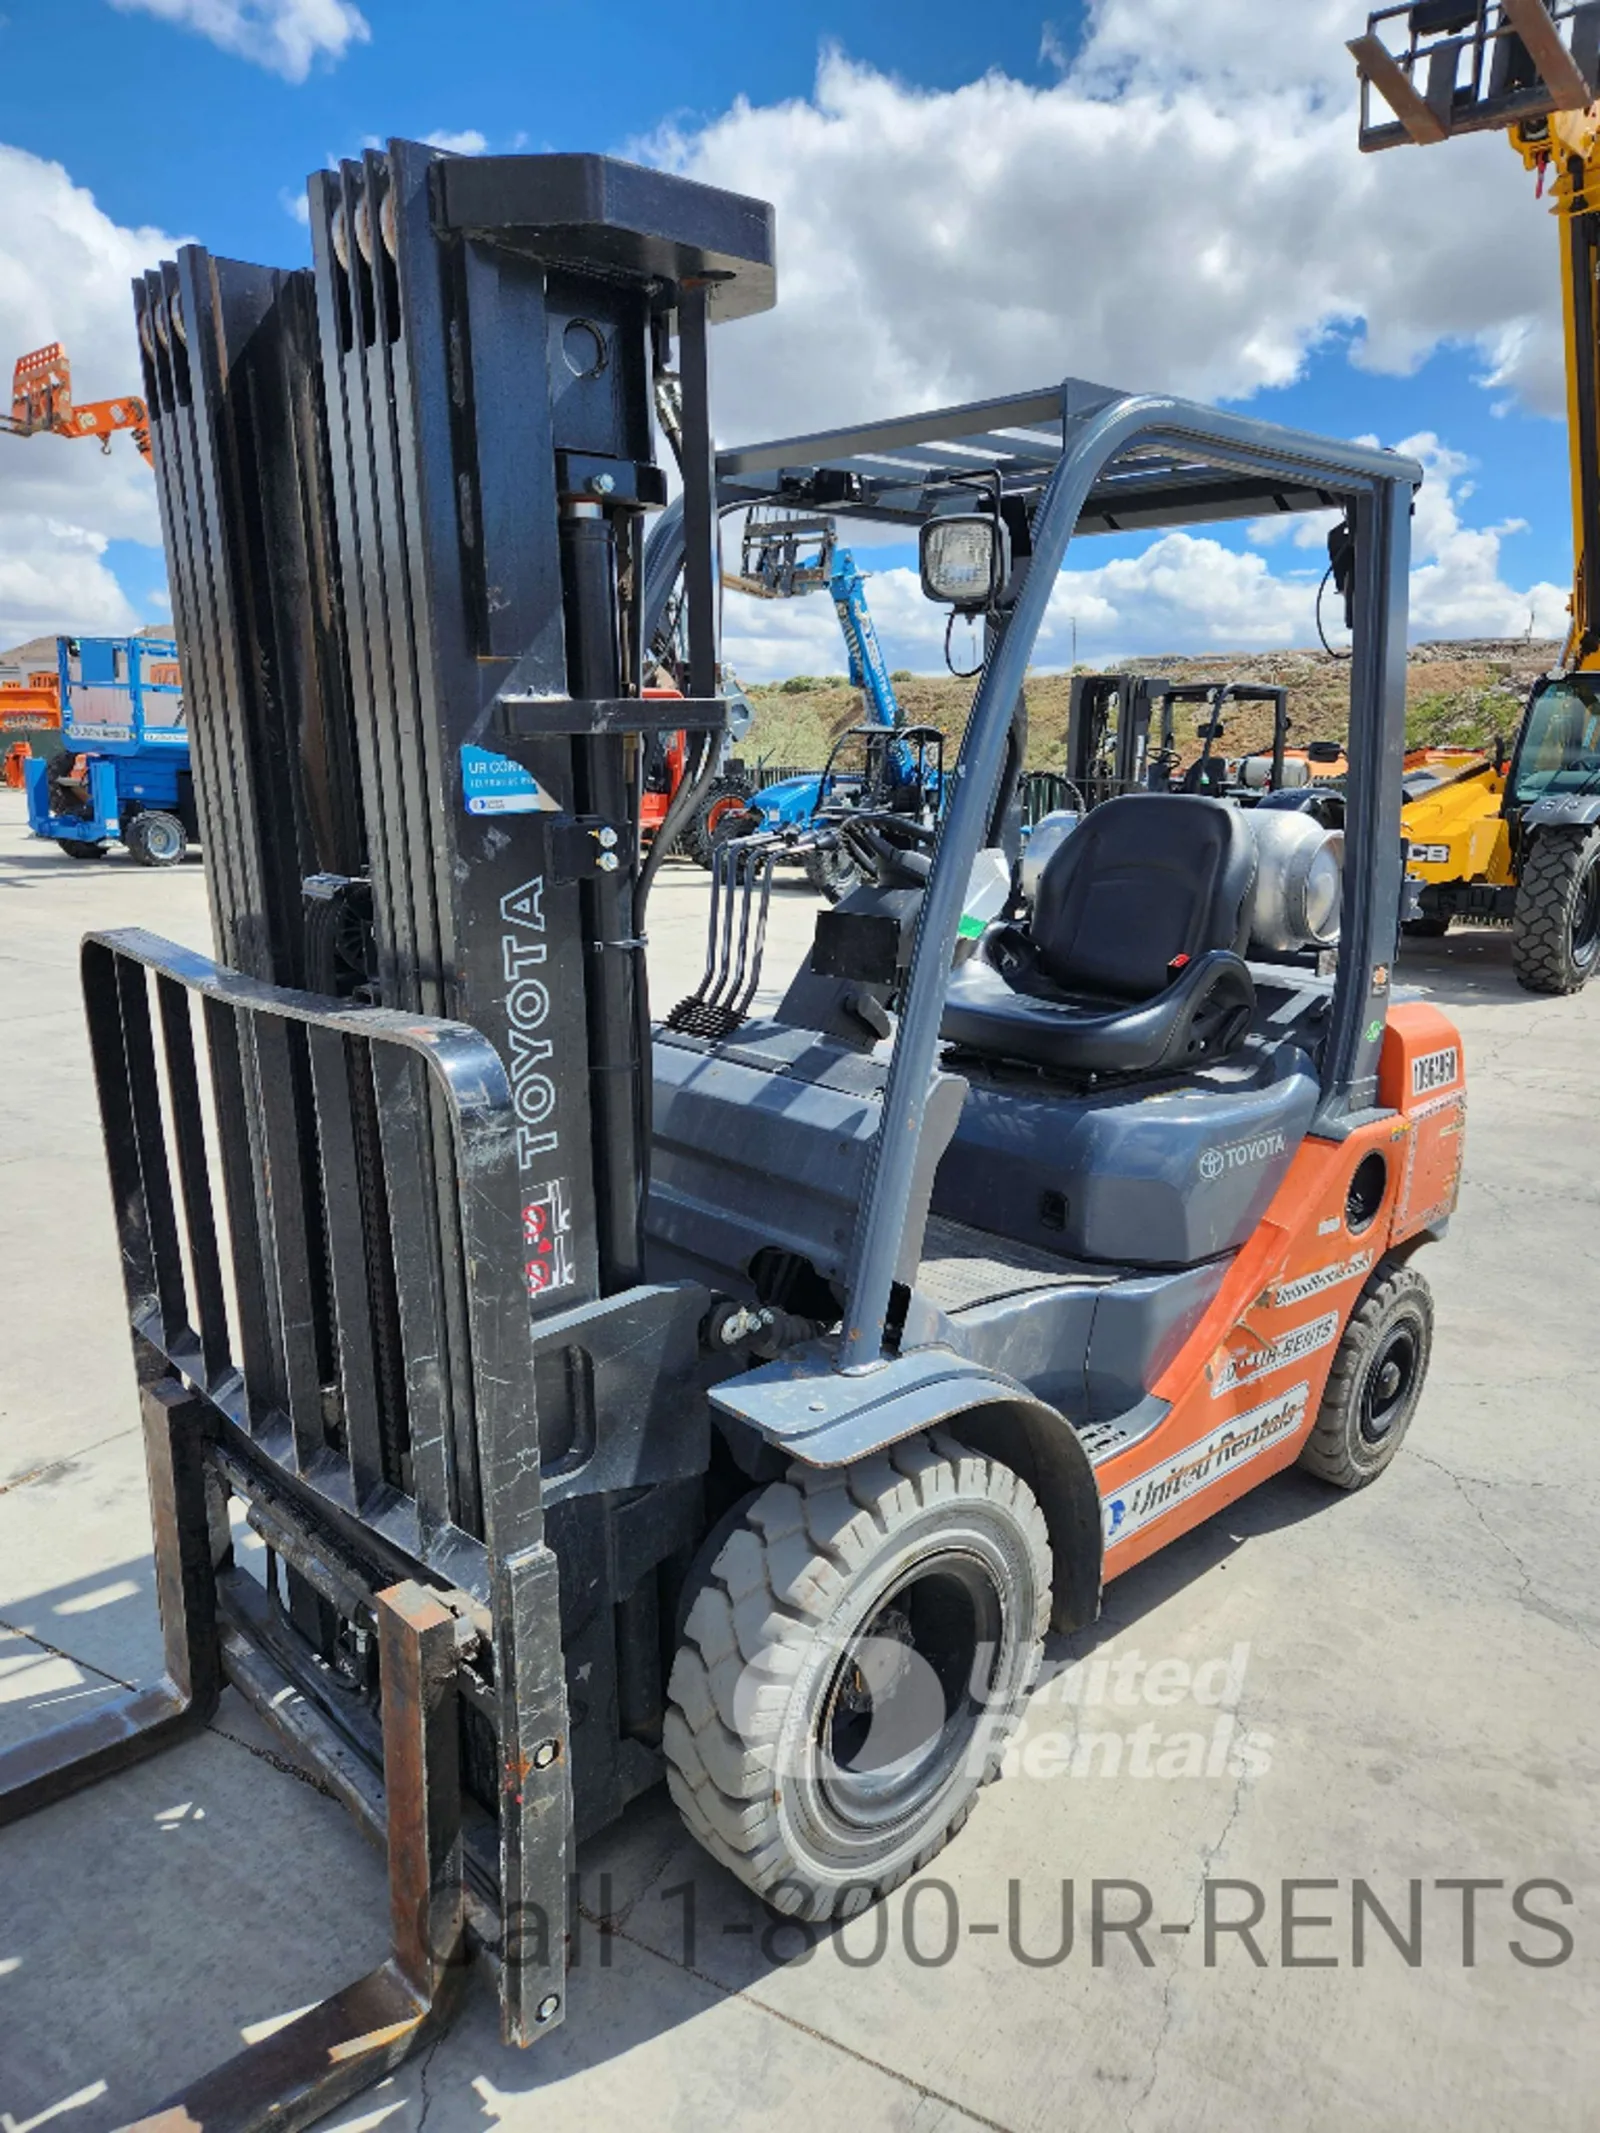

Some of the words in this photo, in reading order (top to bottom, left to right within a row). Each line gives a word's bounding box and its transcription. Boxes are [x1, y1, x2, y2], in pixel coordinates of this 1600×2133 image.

[1407, 844, 1448, 862] CB
[500, 874, 559, 1171] TOYOTA
[1225, 1133, 1286, 1168] TOYOTA
[1131, 1443, 1214, 1516] United
